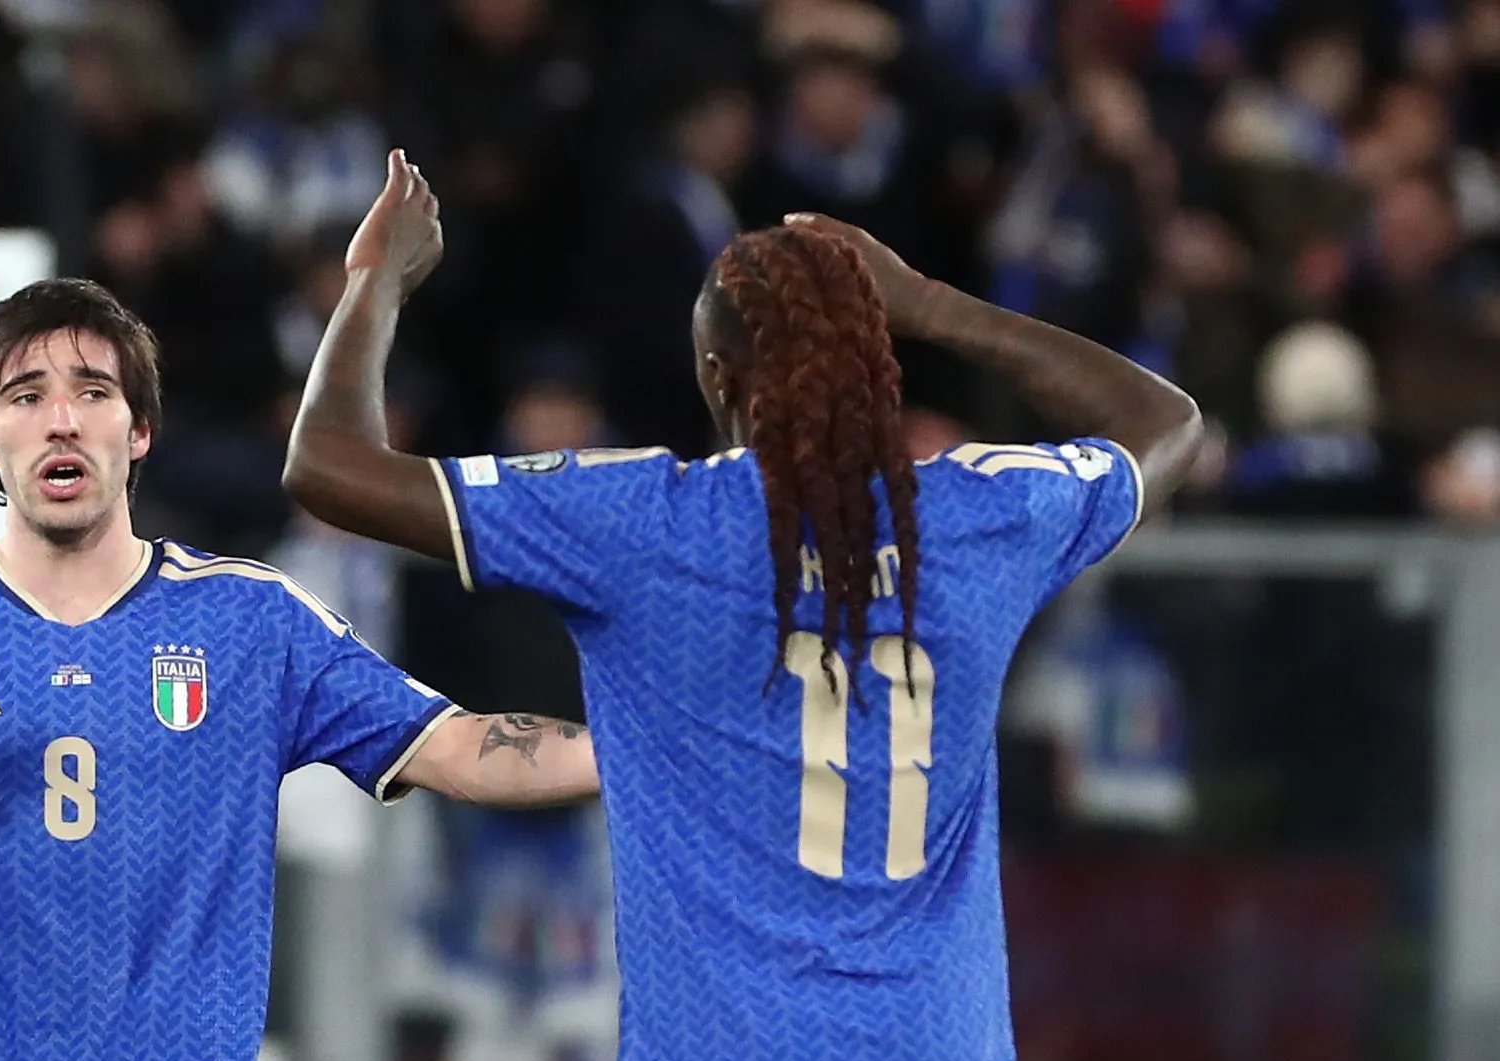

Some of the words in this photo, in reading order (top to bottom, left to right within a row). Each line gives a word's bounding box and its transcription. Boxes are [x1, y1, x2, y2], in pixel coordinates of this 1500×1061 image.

[800, 543, 900, 599] KN
[156, 661, 201, 677] ITALIA
[44, 736, 96, 840] 8
[785, 631, 935, 880] 11
